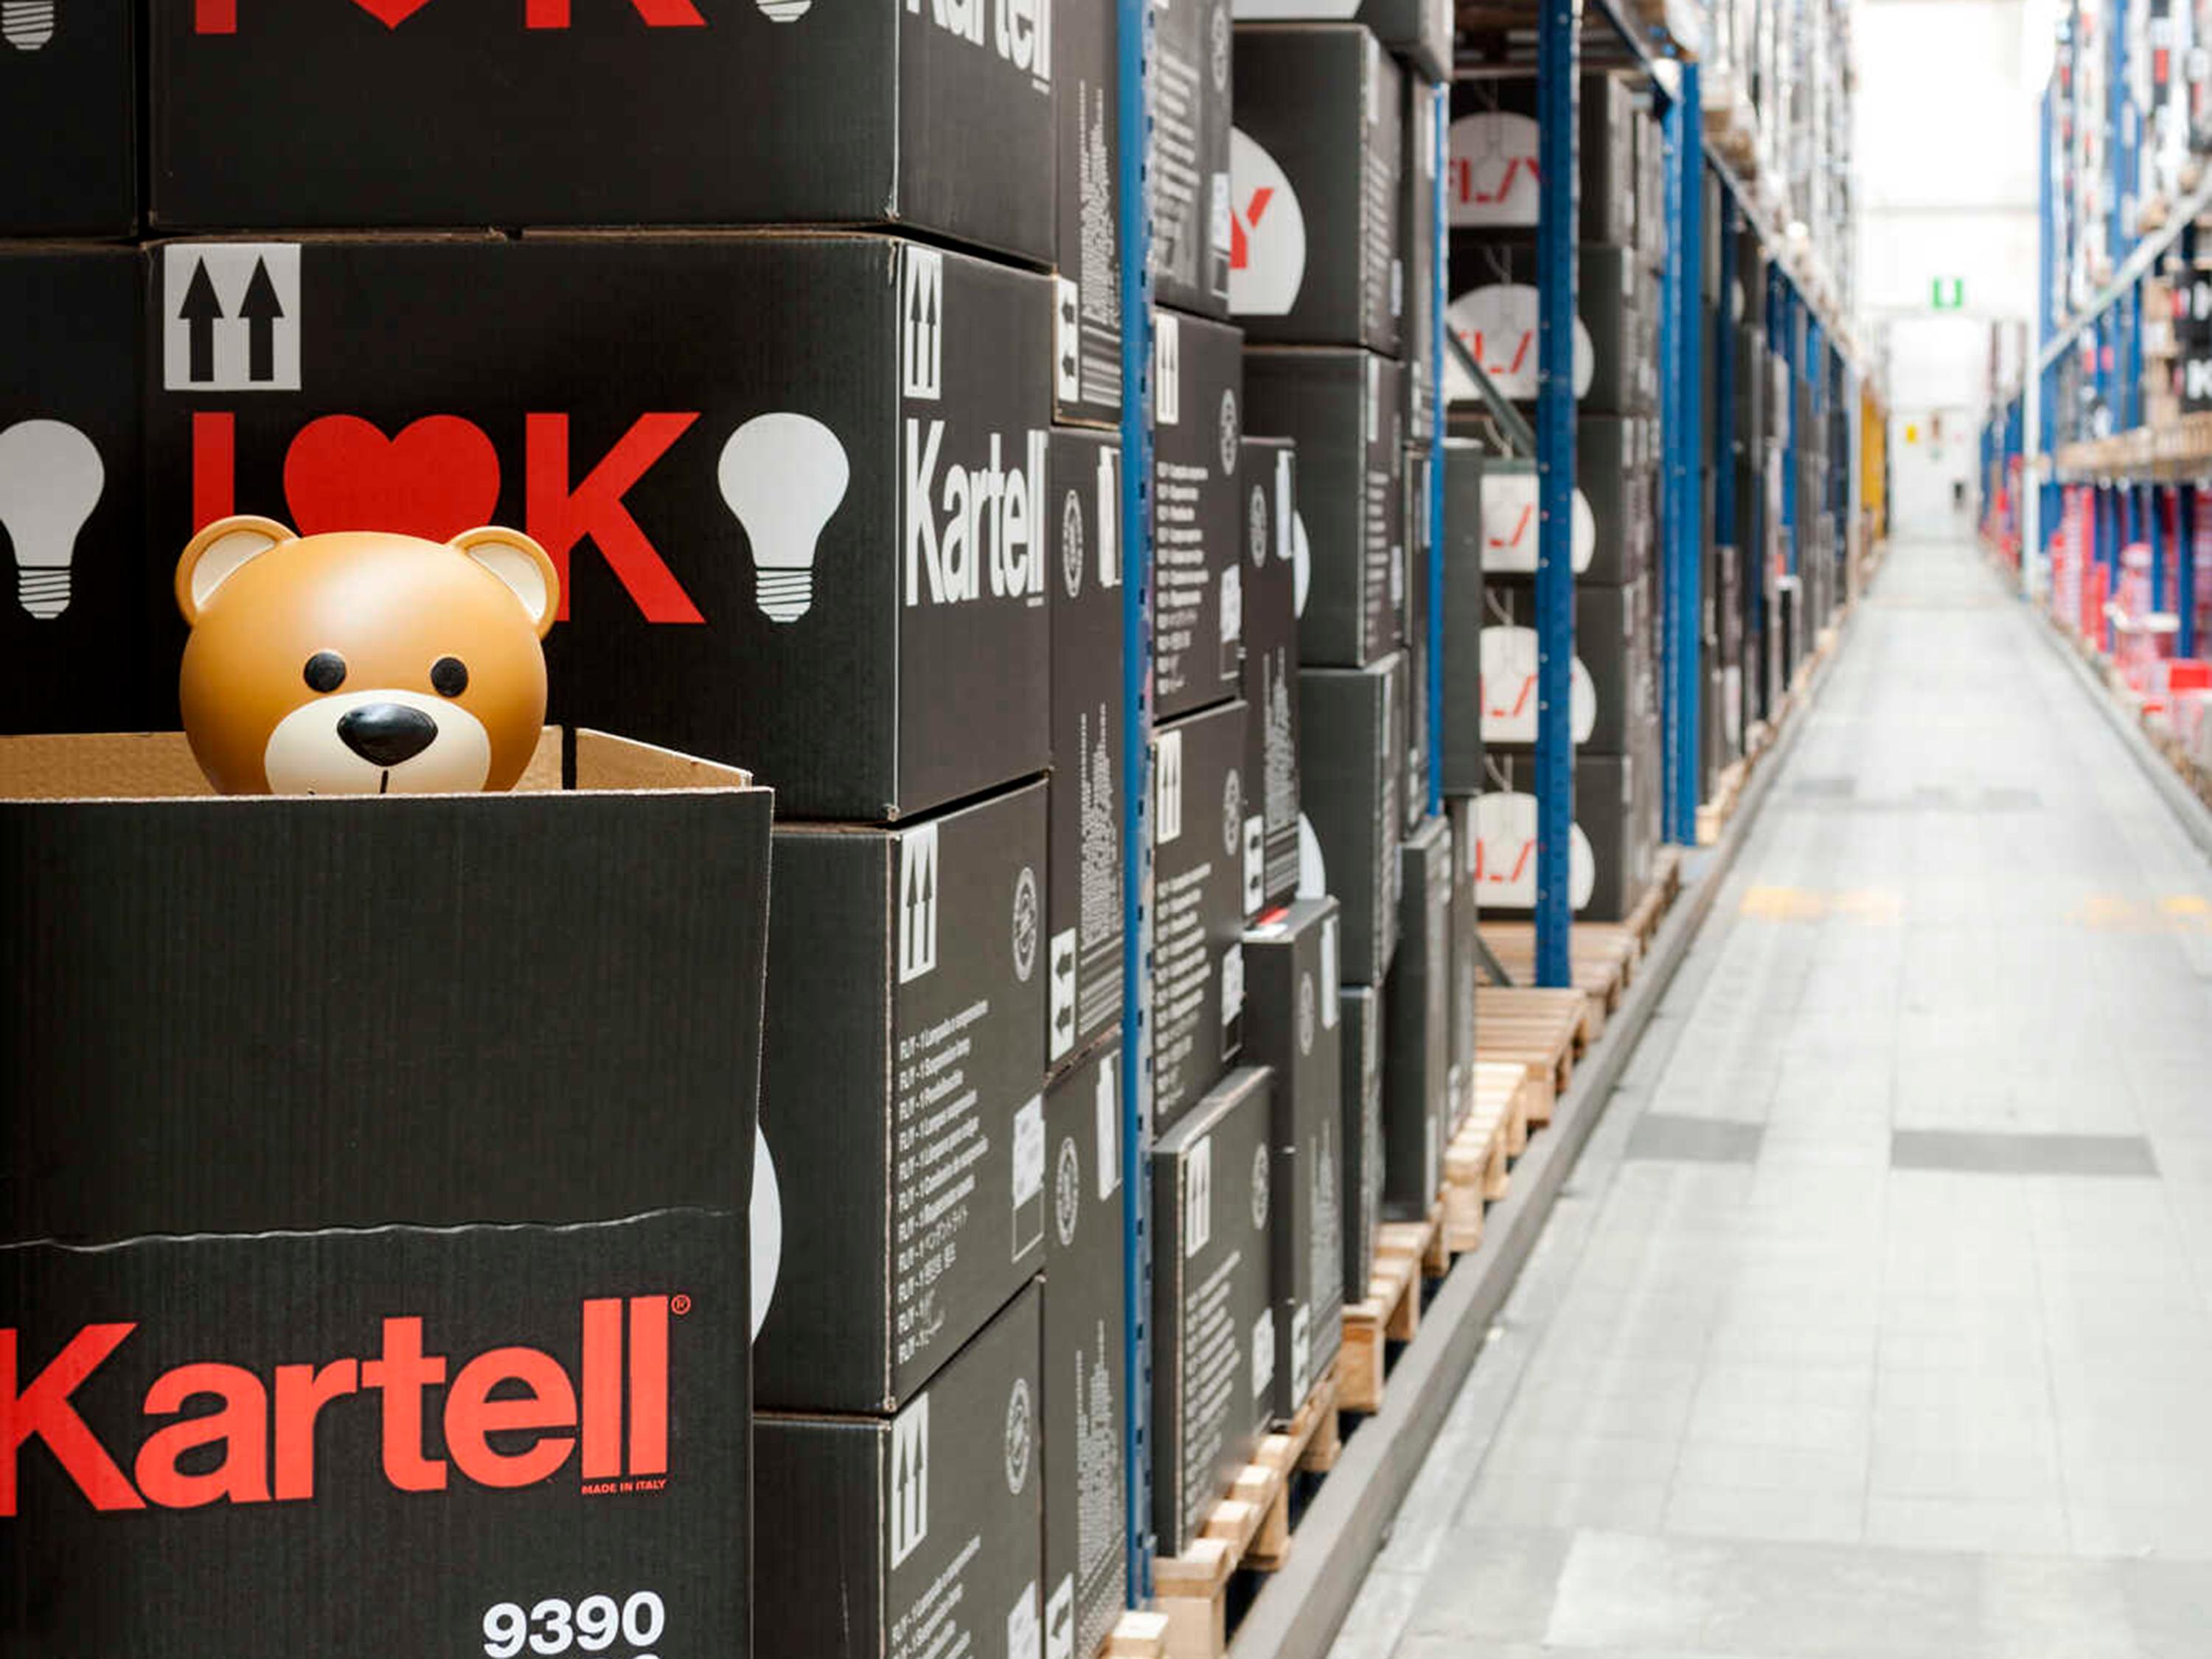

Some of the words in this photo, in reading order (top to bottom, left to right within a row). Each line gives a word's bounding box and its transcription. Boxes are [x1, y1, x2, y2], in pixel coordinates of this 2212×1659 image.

[526, 412, 706, 623] K
[906, 418, 1046, 606] Kartell
[582, 1483, 616, 1494] MADE
[620, 1481, 633, 1492] IN
[636, 1480, 667, 1491] ITALY
[483, 1590, 665, 1658] 9390
